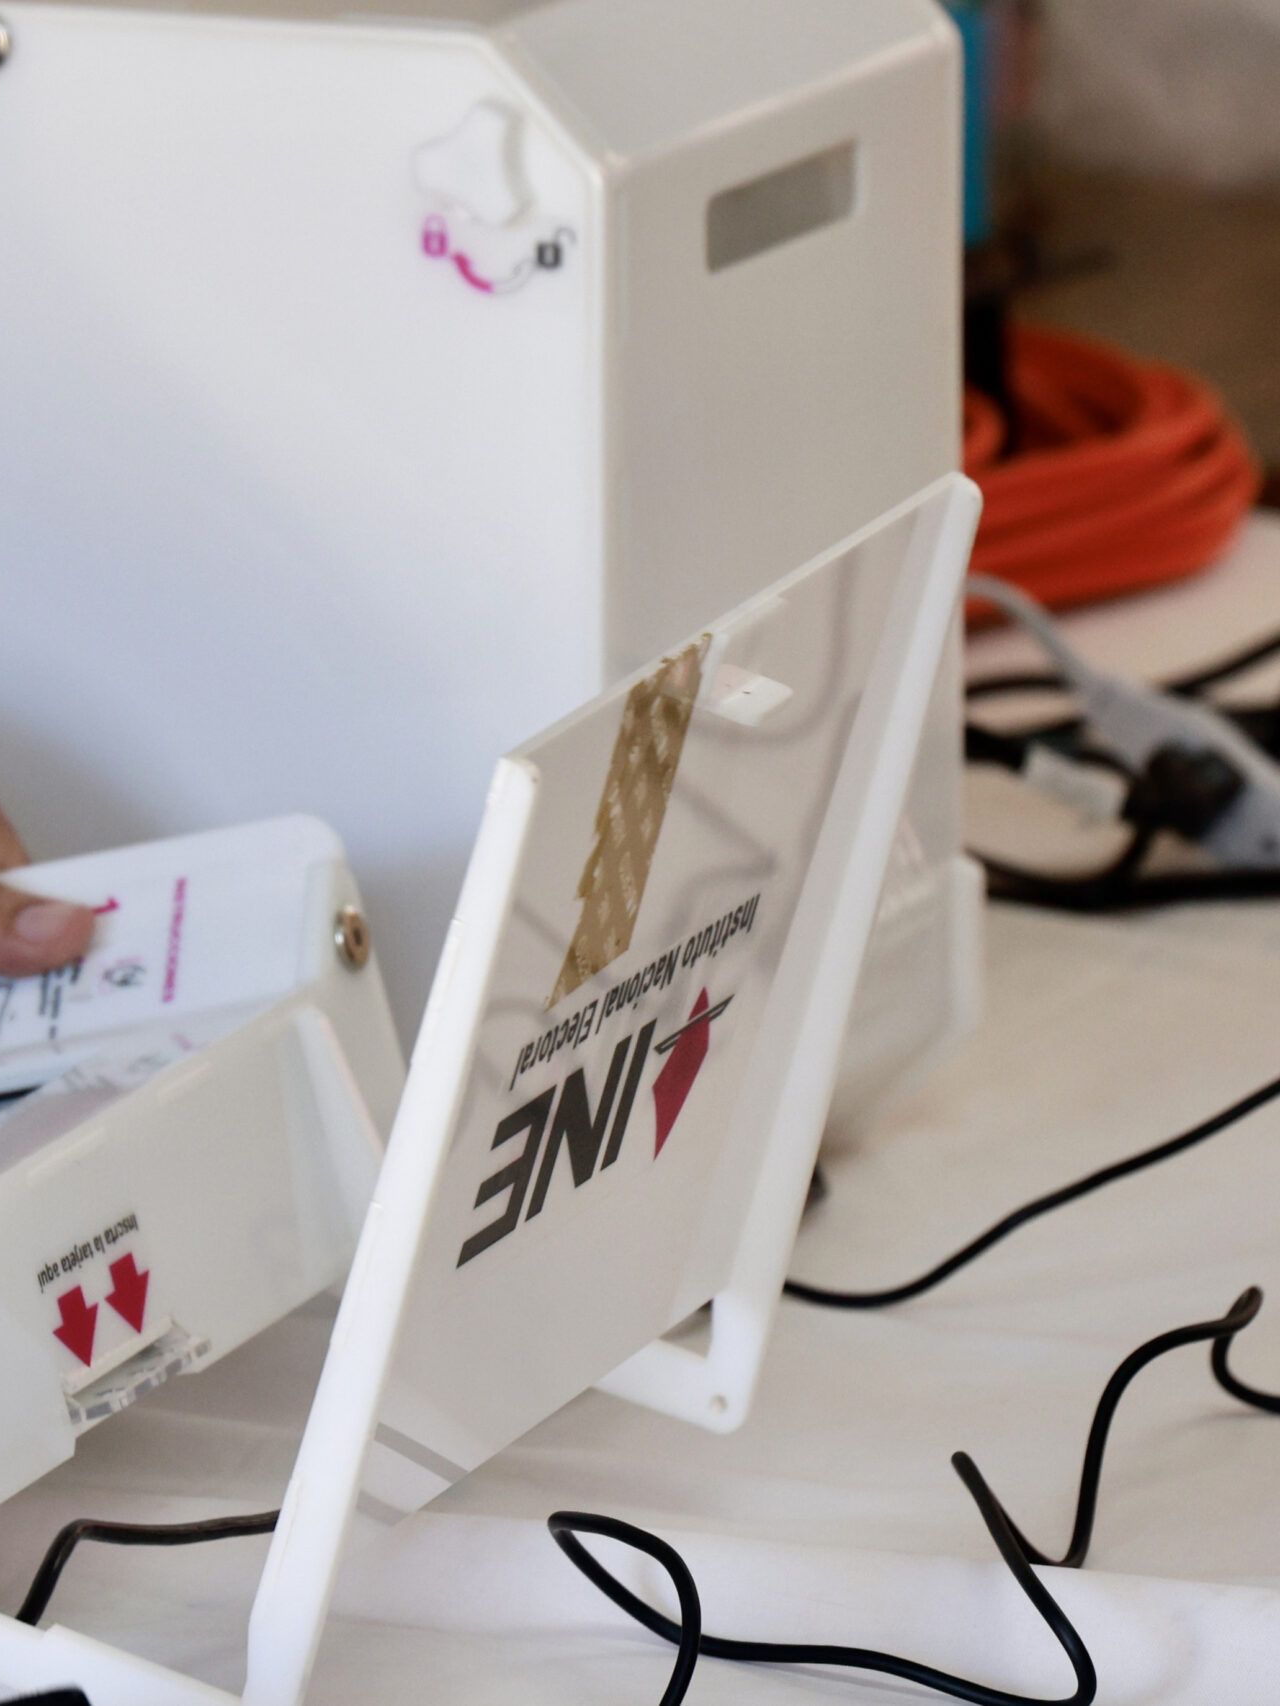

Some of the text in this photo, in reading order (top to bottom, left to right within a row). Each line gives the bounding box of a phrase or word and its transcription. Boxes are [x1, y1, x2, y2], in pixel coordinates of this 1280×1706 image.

[509, 893, 761, 1091] Instituto Nacional Electoral
[456, 1017, 658, 1270] INE
[60, 1241, 94, 1272] tarjeta
[93, 1234, 105, 1254] la
